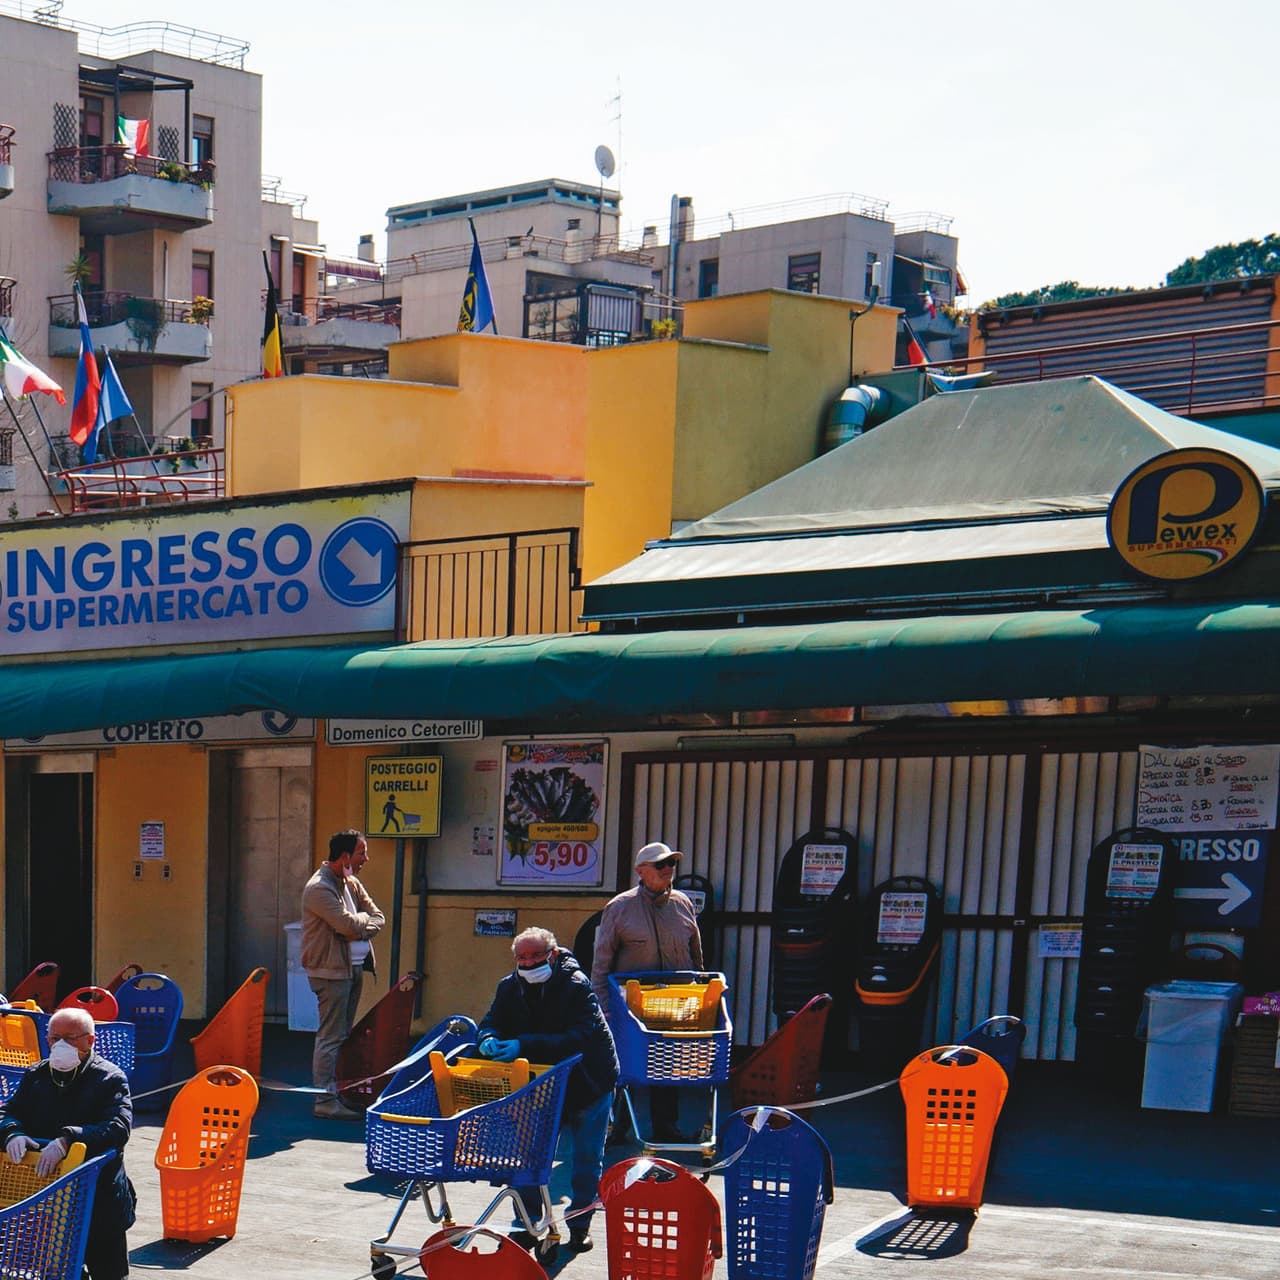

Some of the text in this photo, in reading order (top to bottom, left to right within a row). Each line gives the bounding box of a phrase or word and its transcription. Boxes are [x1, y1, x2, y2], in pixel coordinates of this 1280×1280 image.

[1128, 462, 1243, 544] Pewex
[7, 523, 312, 597] INGRESSO
[7, 579, 309, 633] SUPERMERCATO
[103, 720, 204, 741] COPERTO
[333, 720, 476, 741] Domenico Cetorelli
[371, 763, 437, 775] POSTEGGIO
[373, 781, 429, 792] CARRELLI
[535, 843, 587, 871] 5,90
[1172, 839, 1259, 862] RESSO
